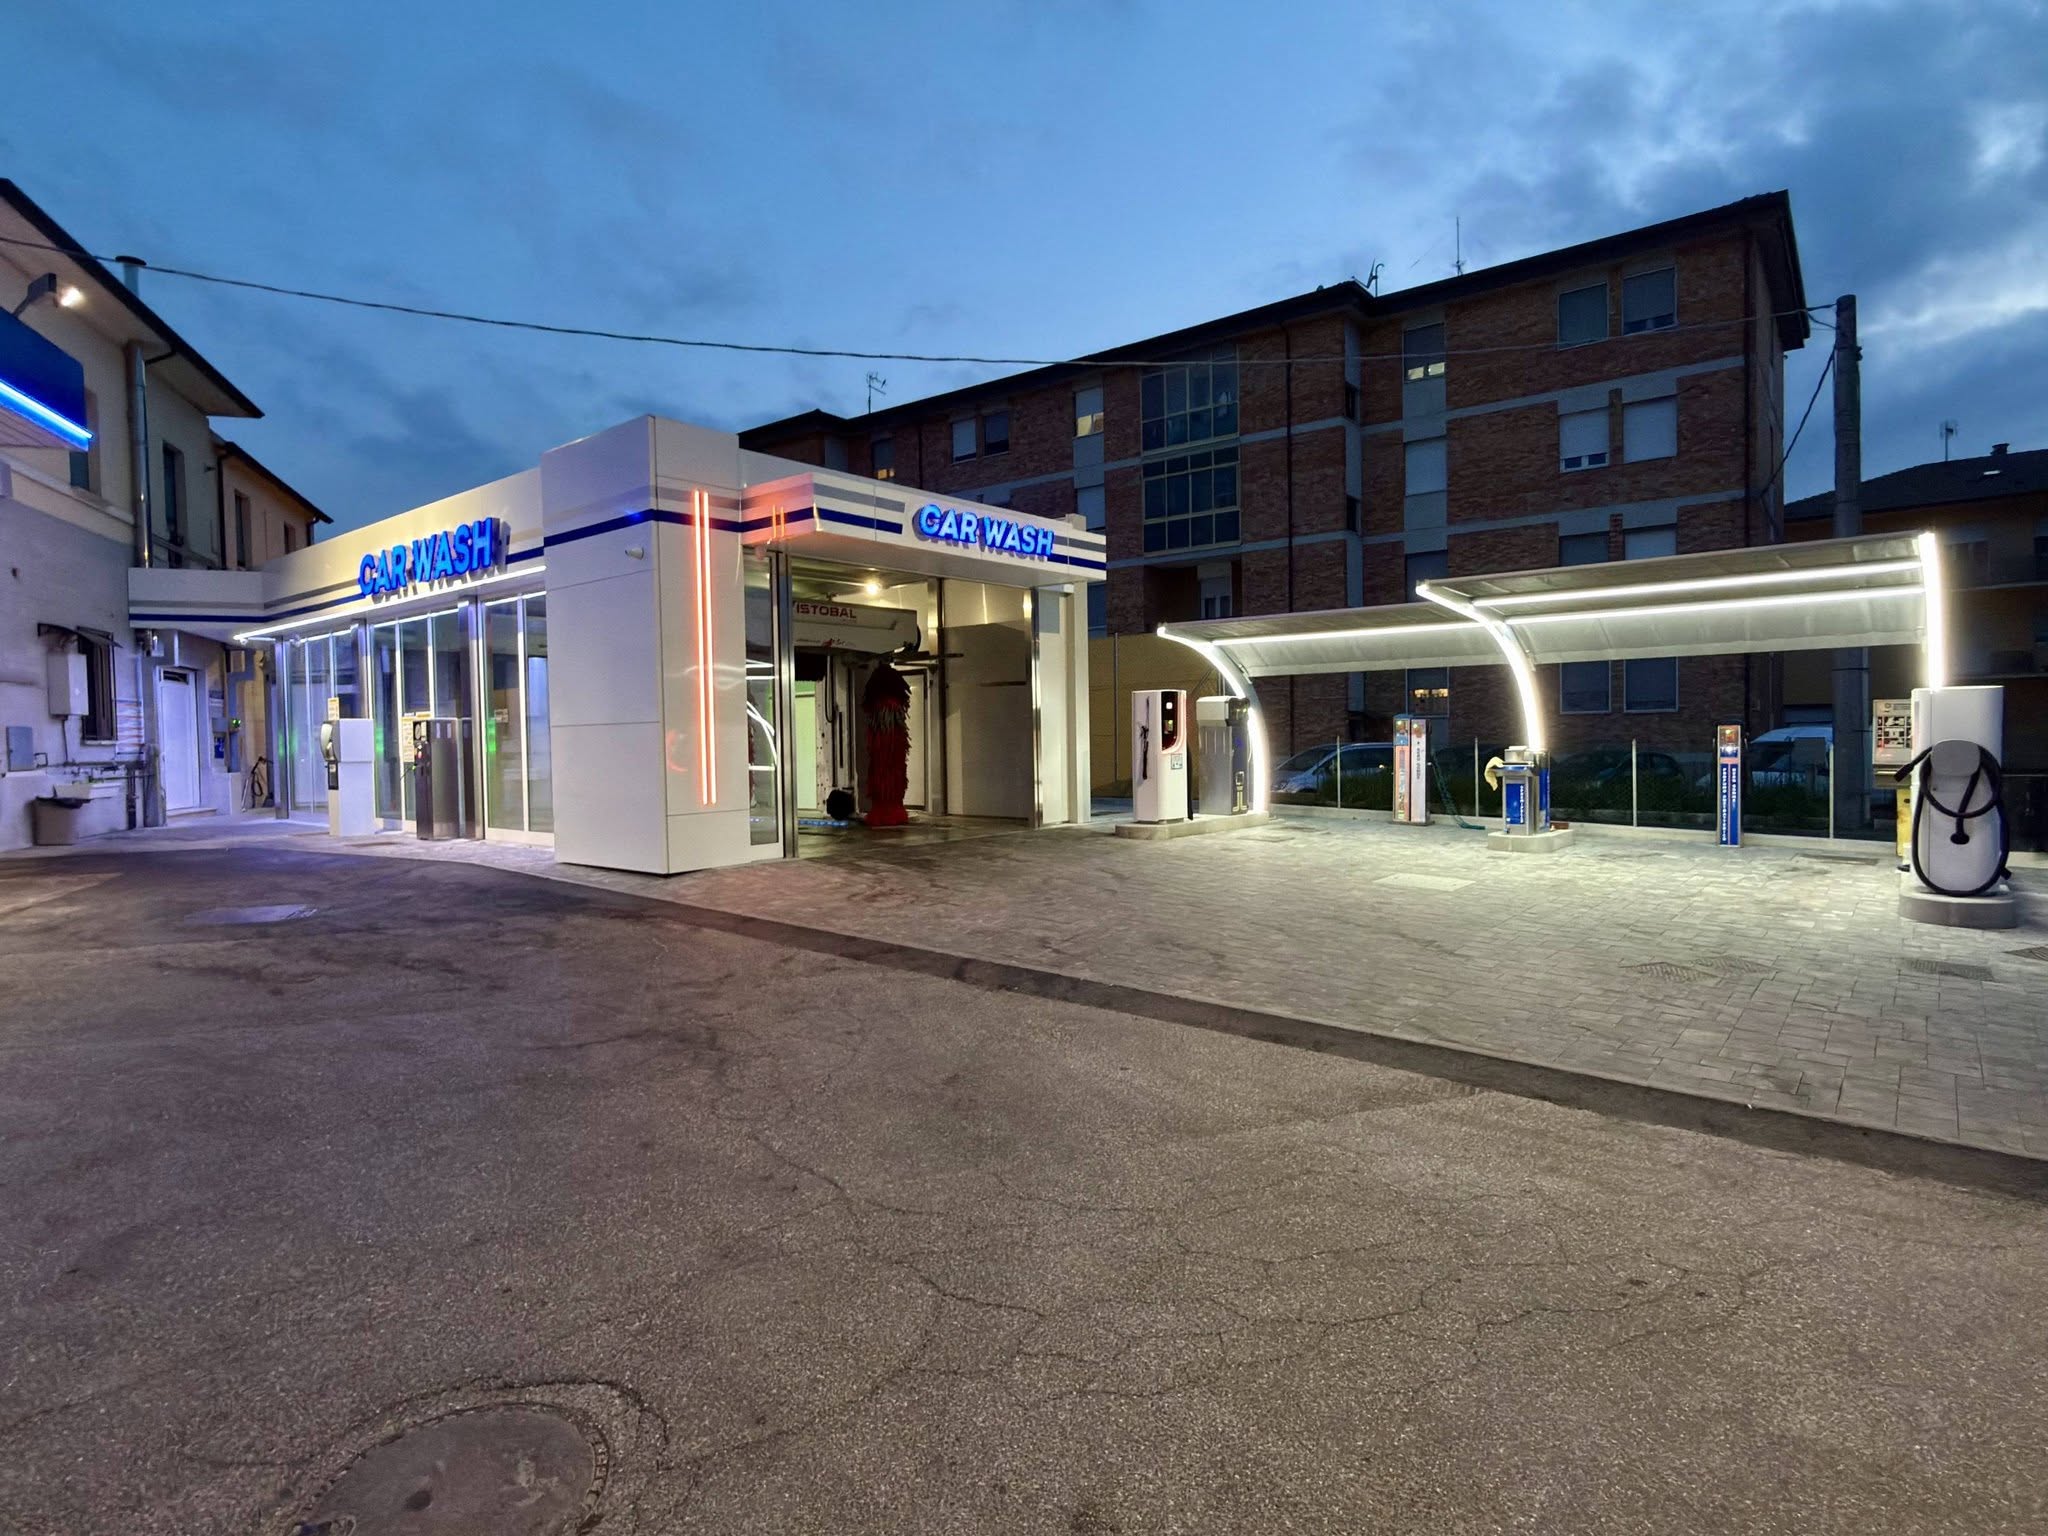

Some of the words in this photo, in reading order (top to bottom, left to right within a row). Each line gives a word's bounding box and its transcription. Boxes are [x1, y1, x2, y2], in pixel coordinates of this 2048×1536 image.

[358, 544, 407, 597] CAR
[412, 517, 493, 582] WASH
[918, 504, 978, 544] CAR
[983, 515, 1054, 557] WASH
[796, 602, 857, 619] ISTOBAL
